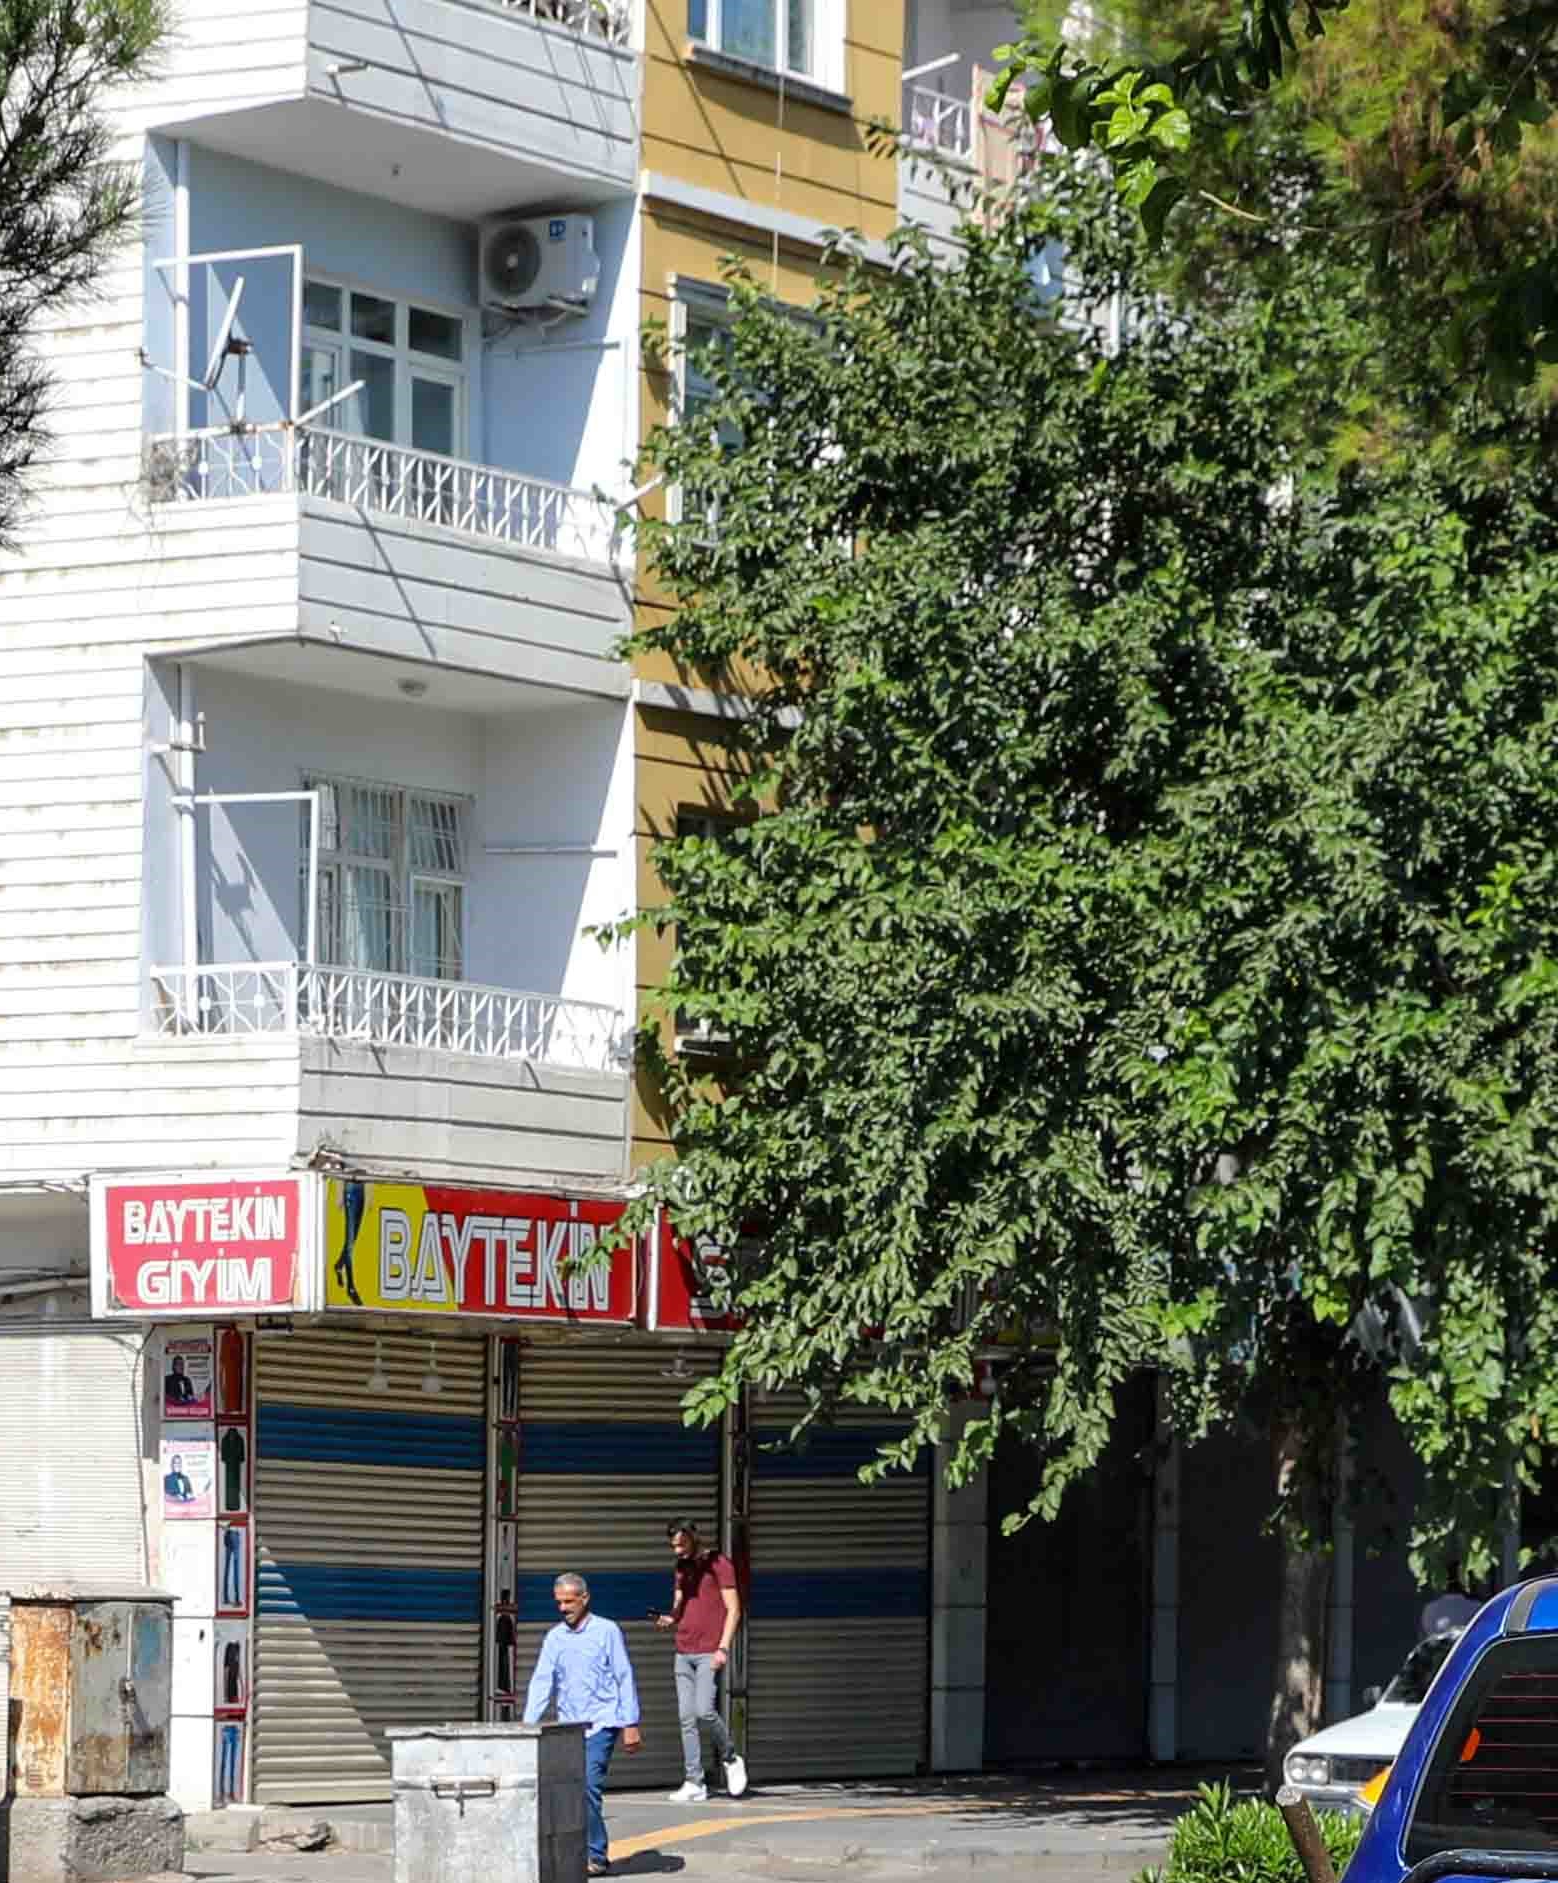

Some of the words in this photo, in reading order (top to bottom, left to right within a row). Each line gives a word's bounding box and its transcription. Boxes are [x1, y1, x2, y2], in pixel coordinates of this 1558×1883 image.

[122, 1186, 286, 1244] BAYTEKİN
[136, 1250, 273, 1304] GİYİM
[379, 1201, 611, 1311] BAYTEKİN
